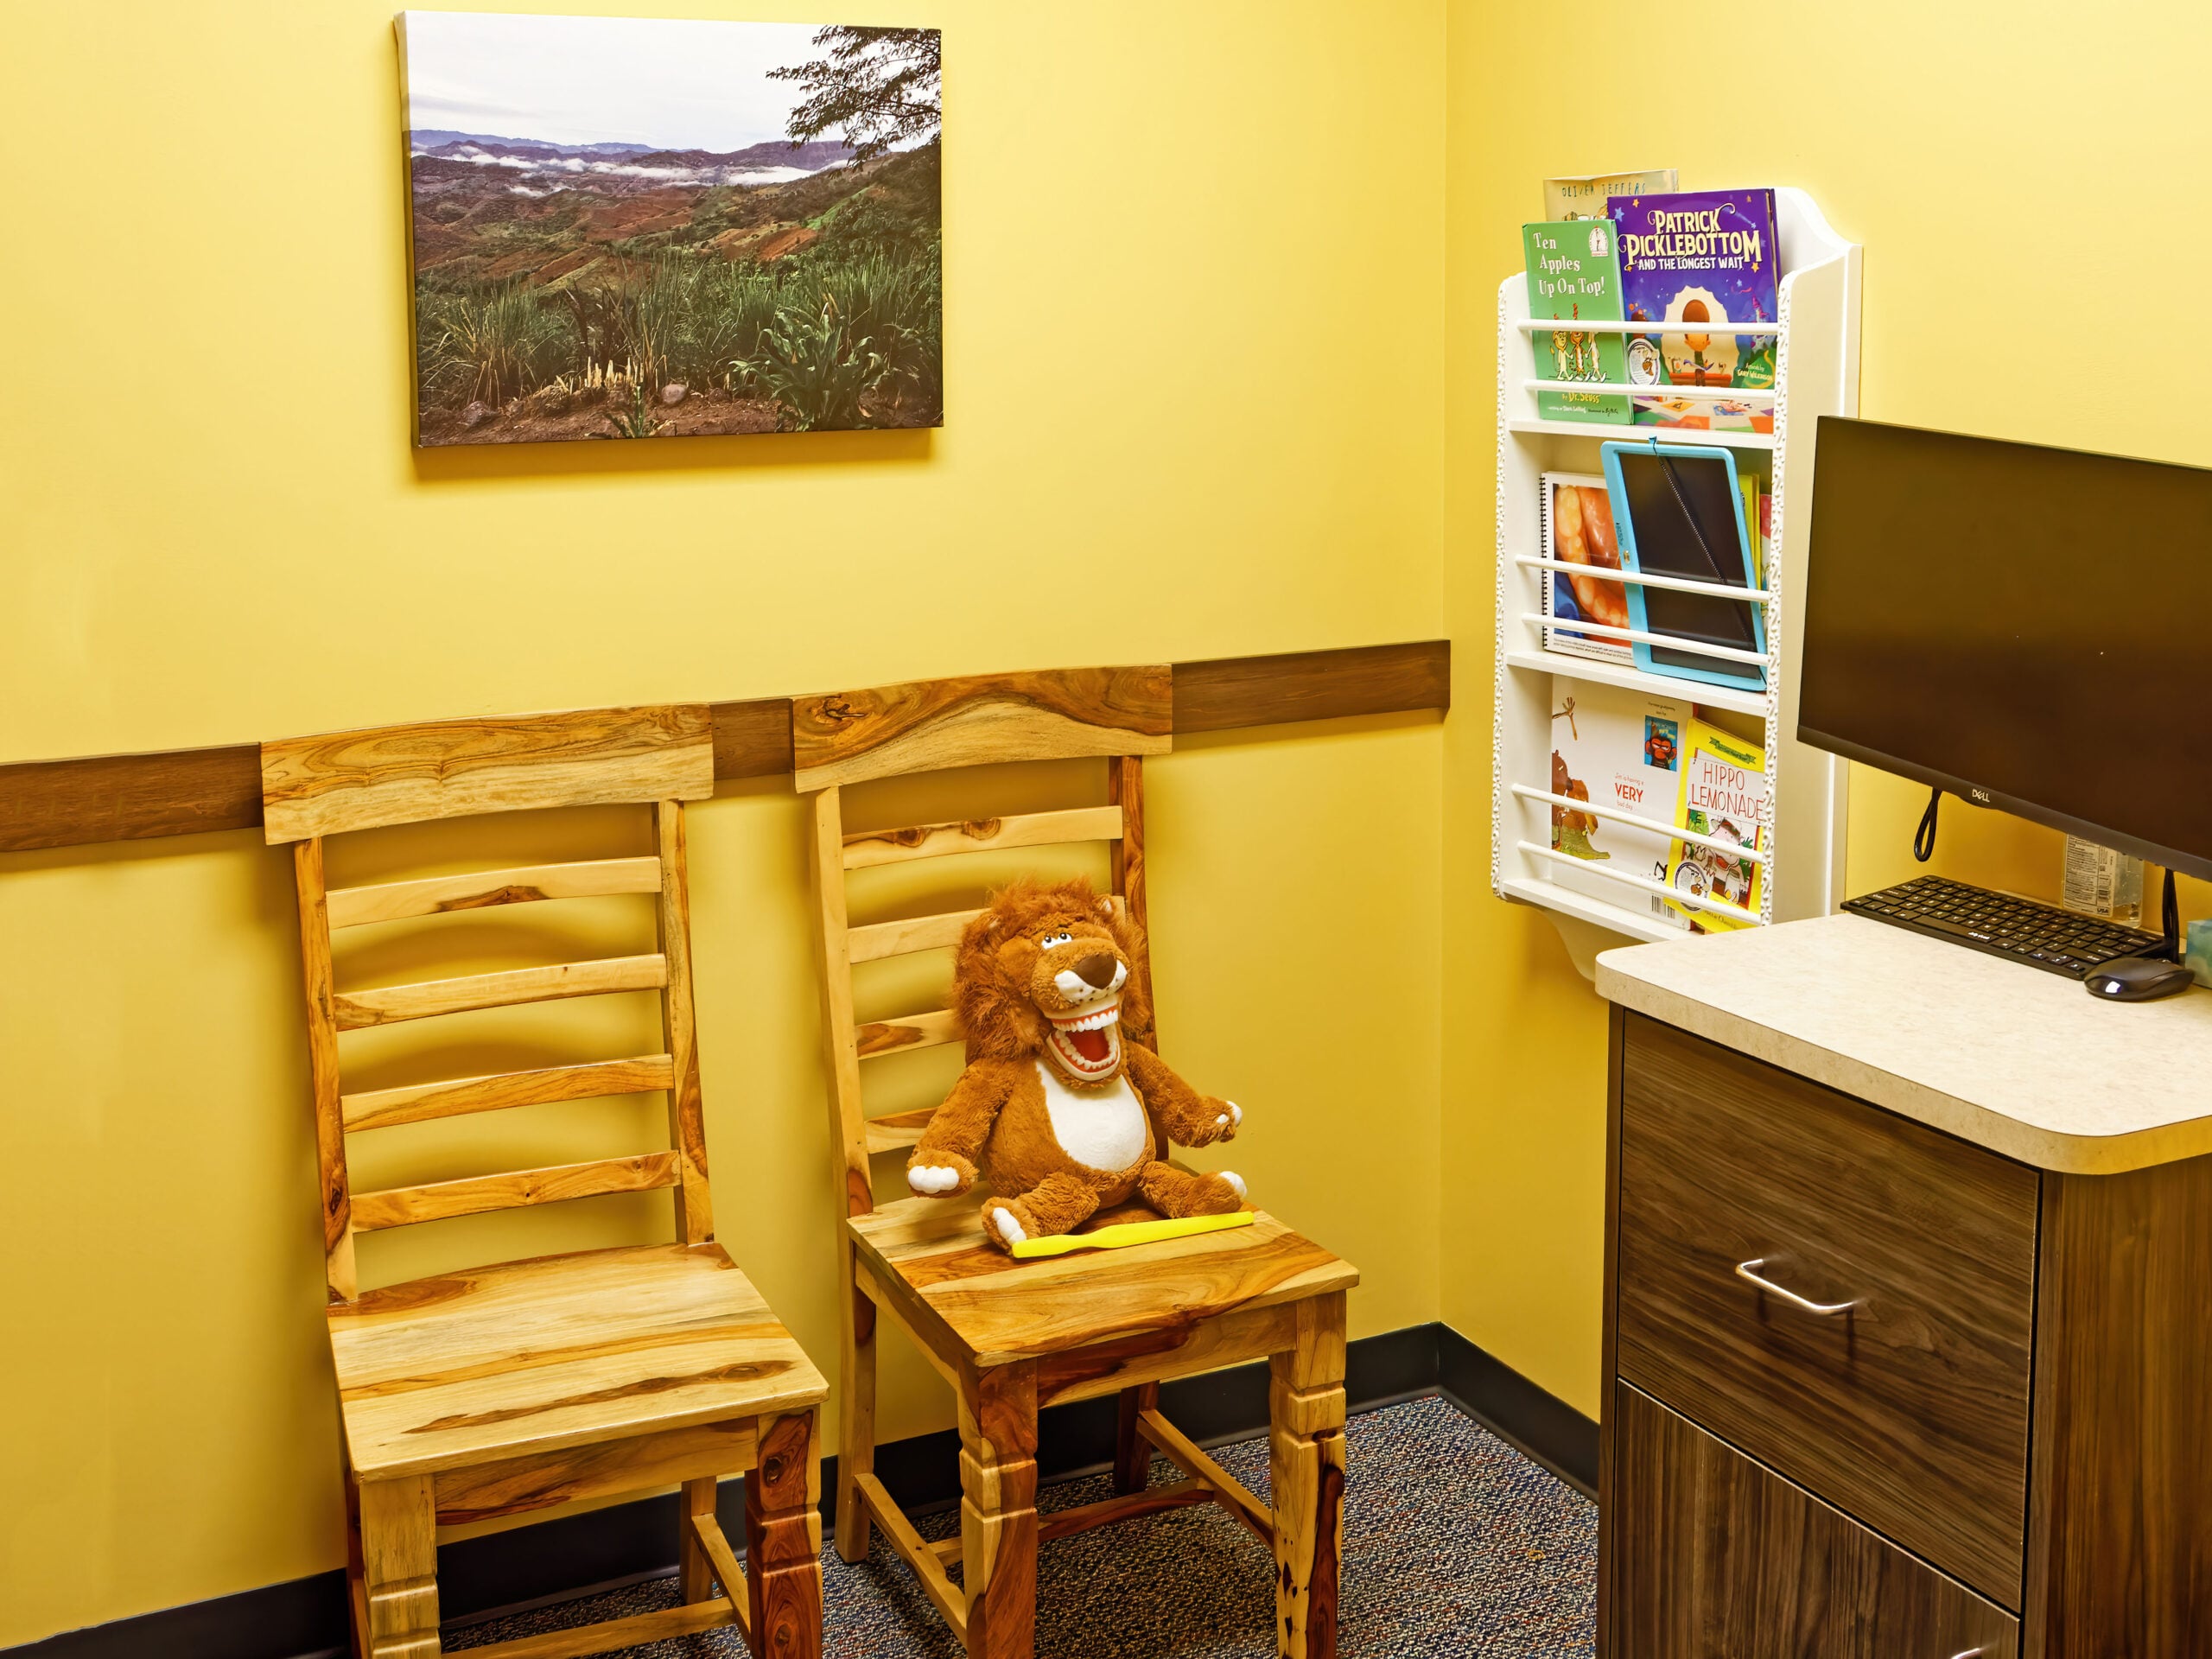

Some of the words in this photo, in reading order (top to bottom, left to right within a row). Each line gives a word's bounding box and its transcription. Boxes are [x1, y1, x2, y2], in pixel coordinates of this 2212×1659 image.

[1561, 184, 1594, 198] OLIVER
[1601, 182, 1646, 195] JEFFERS
[1648, 203, 1735, 235] PATRICK
[1533, 232, 1557, 250] Ten
[1618, 230, 1763, 270] PICKLEBOTTOM
[1539, 253, 1581, 275] Apples
[1638, 258, 1656, 271] AND
[1659, 258, 1676, 270] THE
[1677, 257, 1715, 270] LONGEST
[1719, 256, 1744, 270] WAIT
[1538, 279, 1555, 298] Up
[1557, 277, 1575, 295] On
[1578, 276, 1605, 297] Top!
[1568, 391, 1580, 403] Dr.
[1580, 392, 1600, 404] Seuss
[1703, 762, 1745, 791] HIPPO
[1614, 782, 1643, 804] VERY
[1691, 783, 1764, 822] LEMONADE
[1972, 788, 1990, 803] DELL
